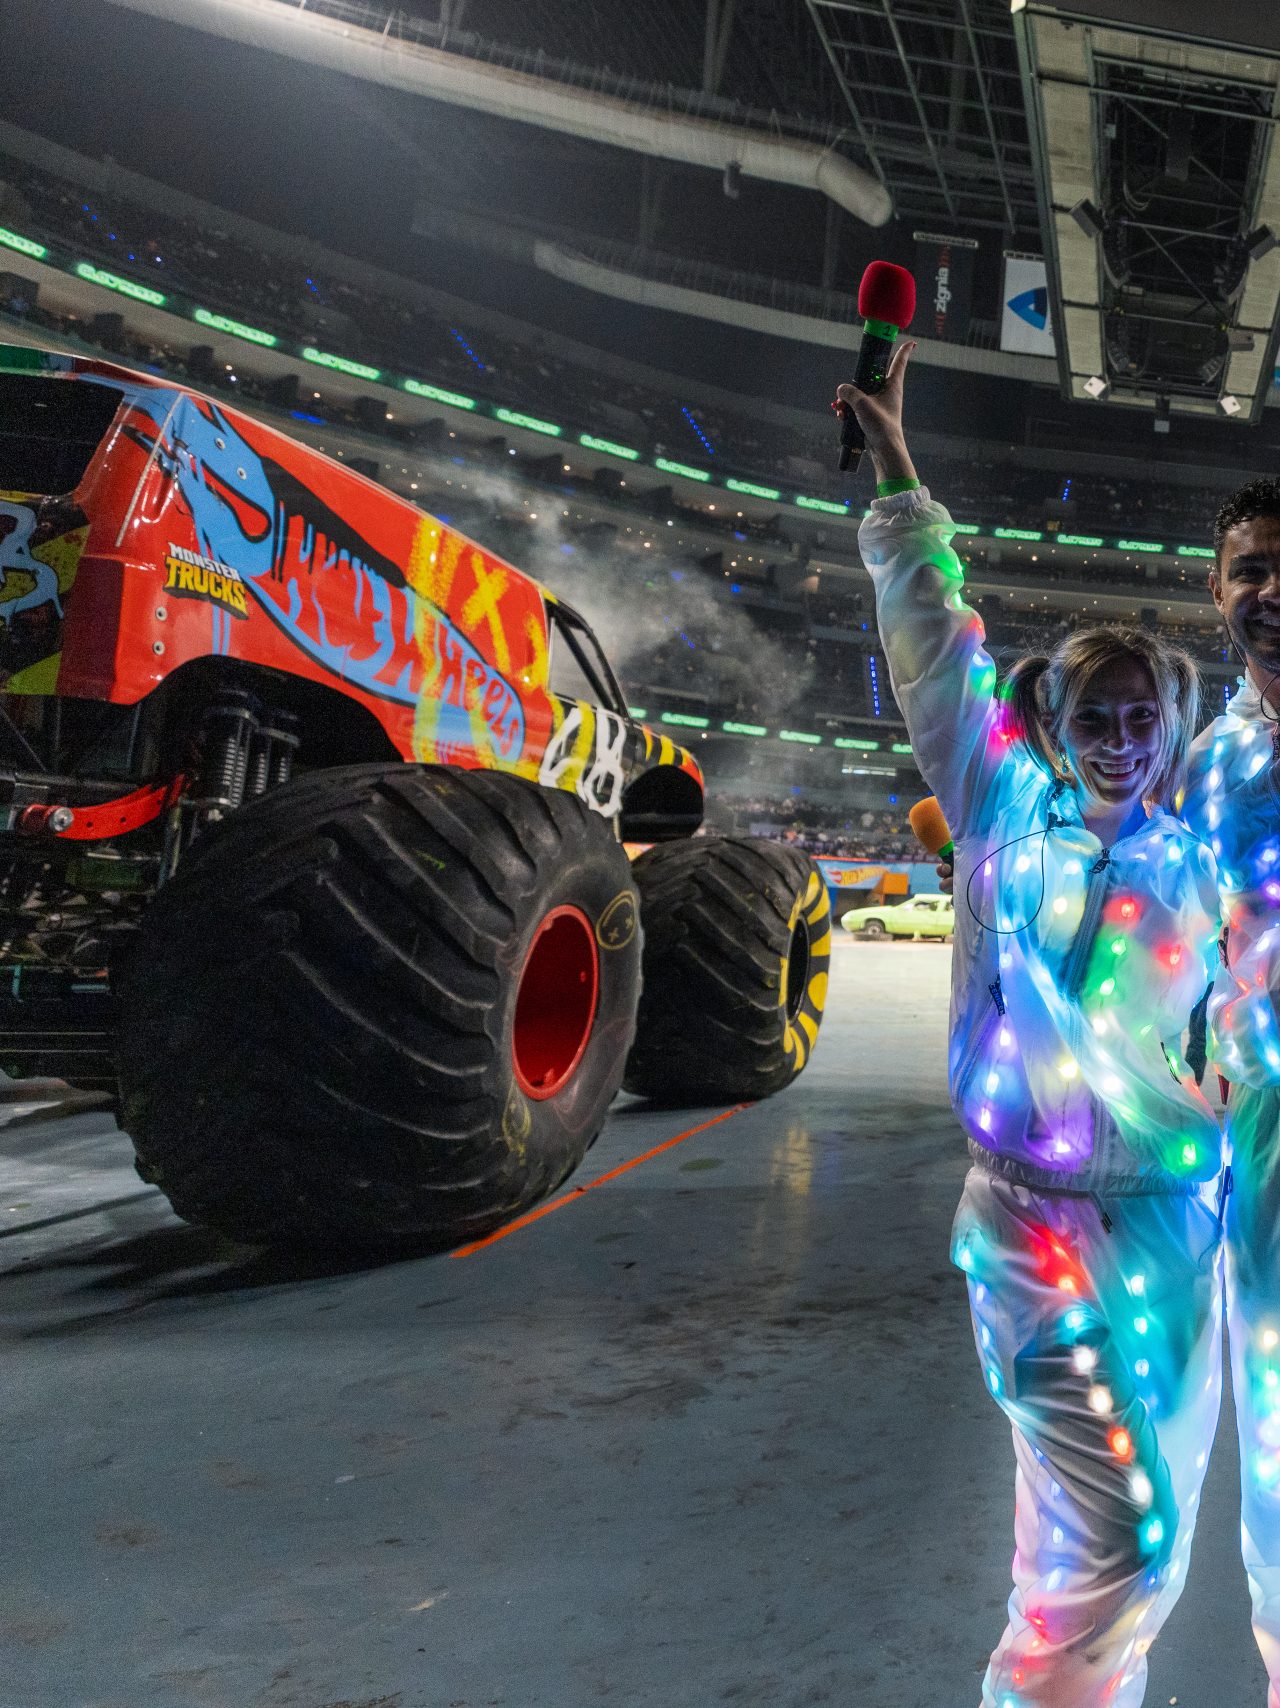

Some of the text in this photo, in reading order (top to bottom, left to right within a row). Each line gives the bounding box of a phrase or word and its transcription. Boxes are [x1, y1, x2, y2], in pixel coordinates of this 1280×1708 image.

[934, 267, 951, 313] zignia
[168, 541, 242, 582] MONSTER
[163, 555, 249, 616] TRUCKS
